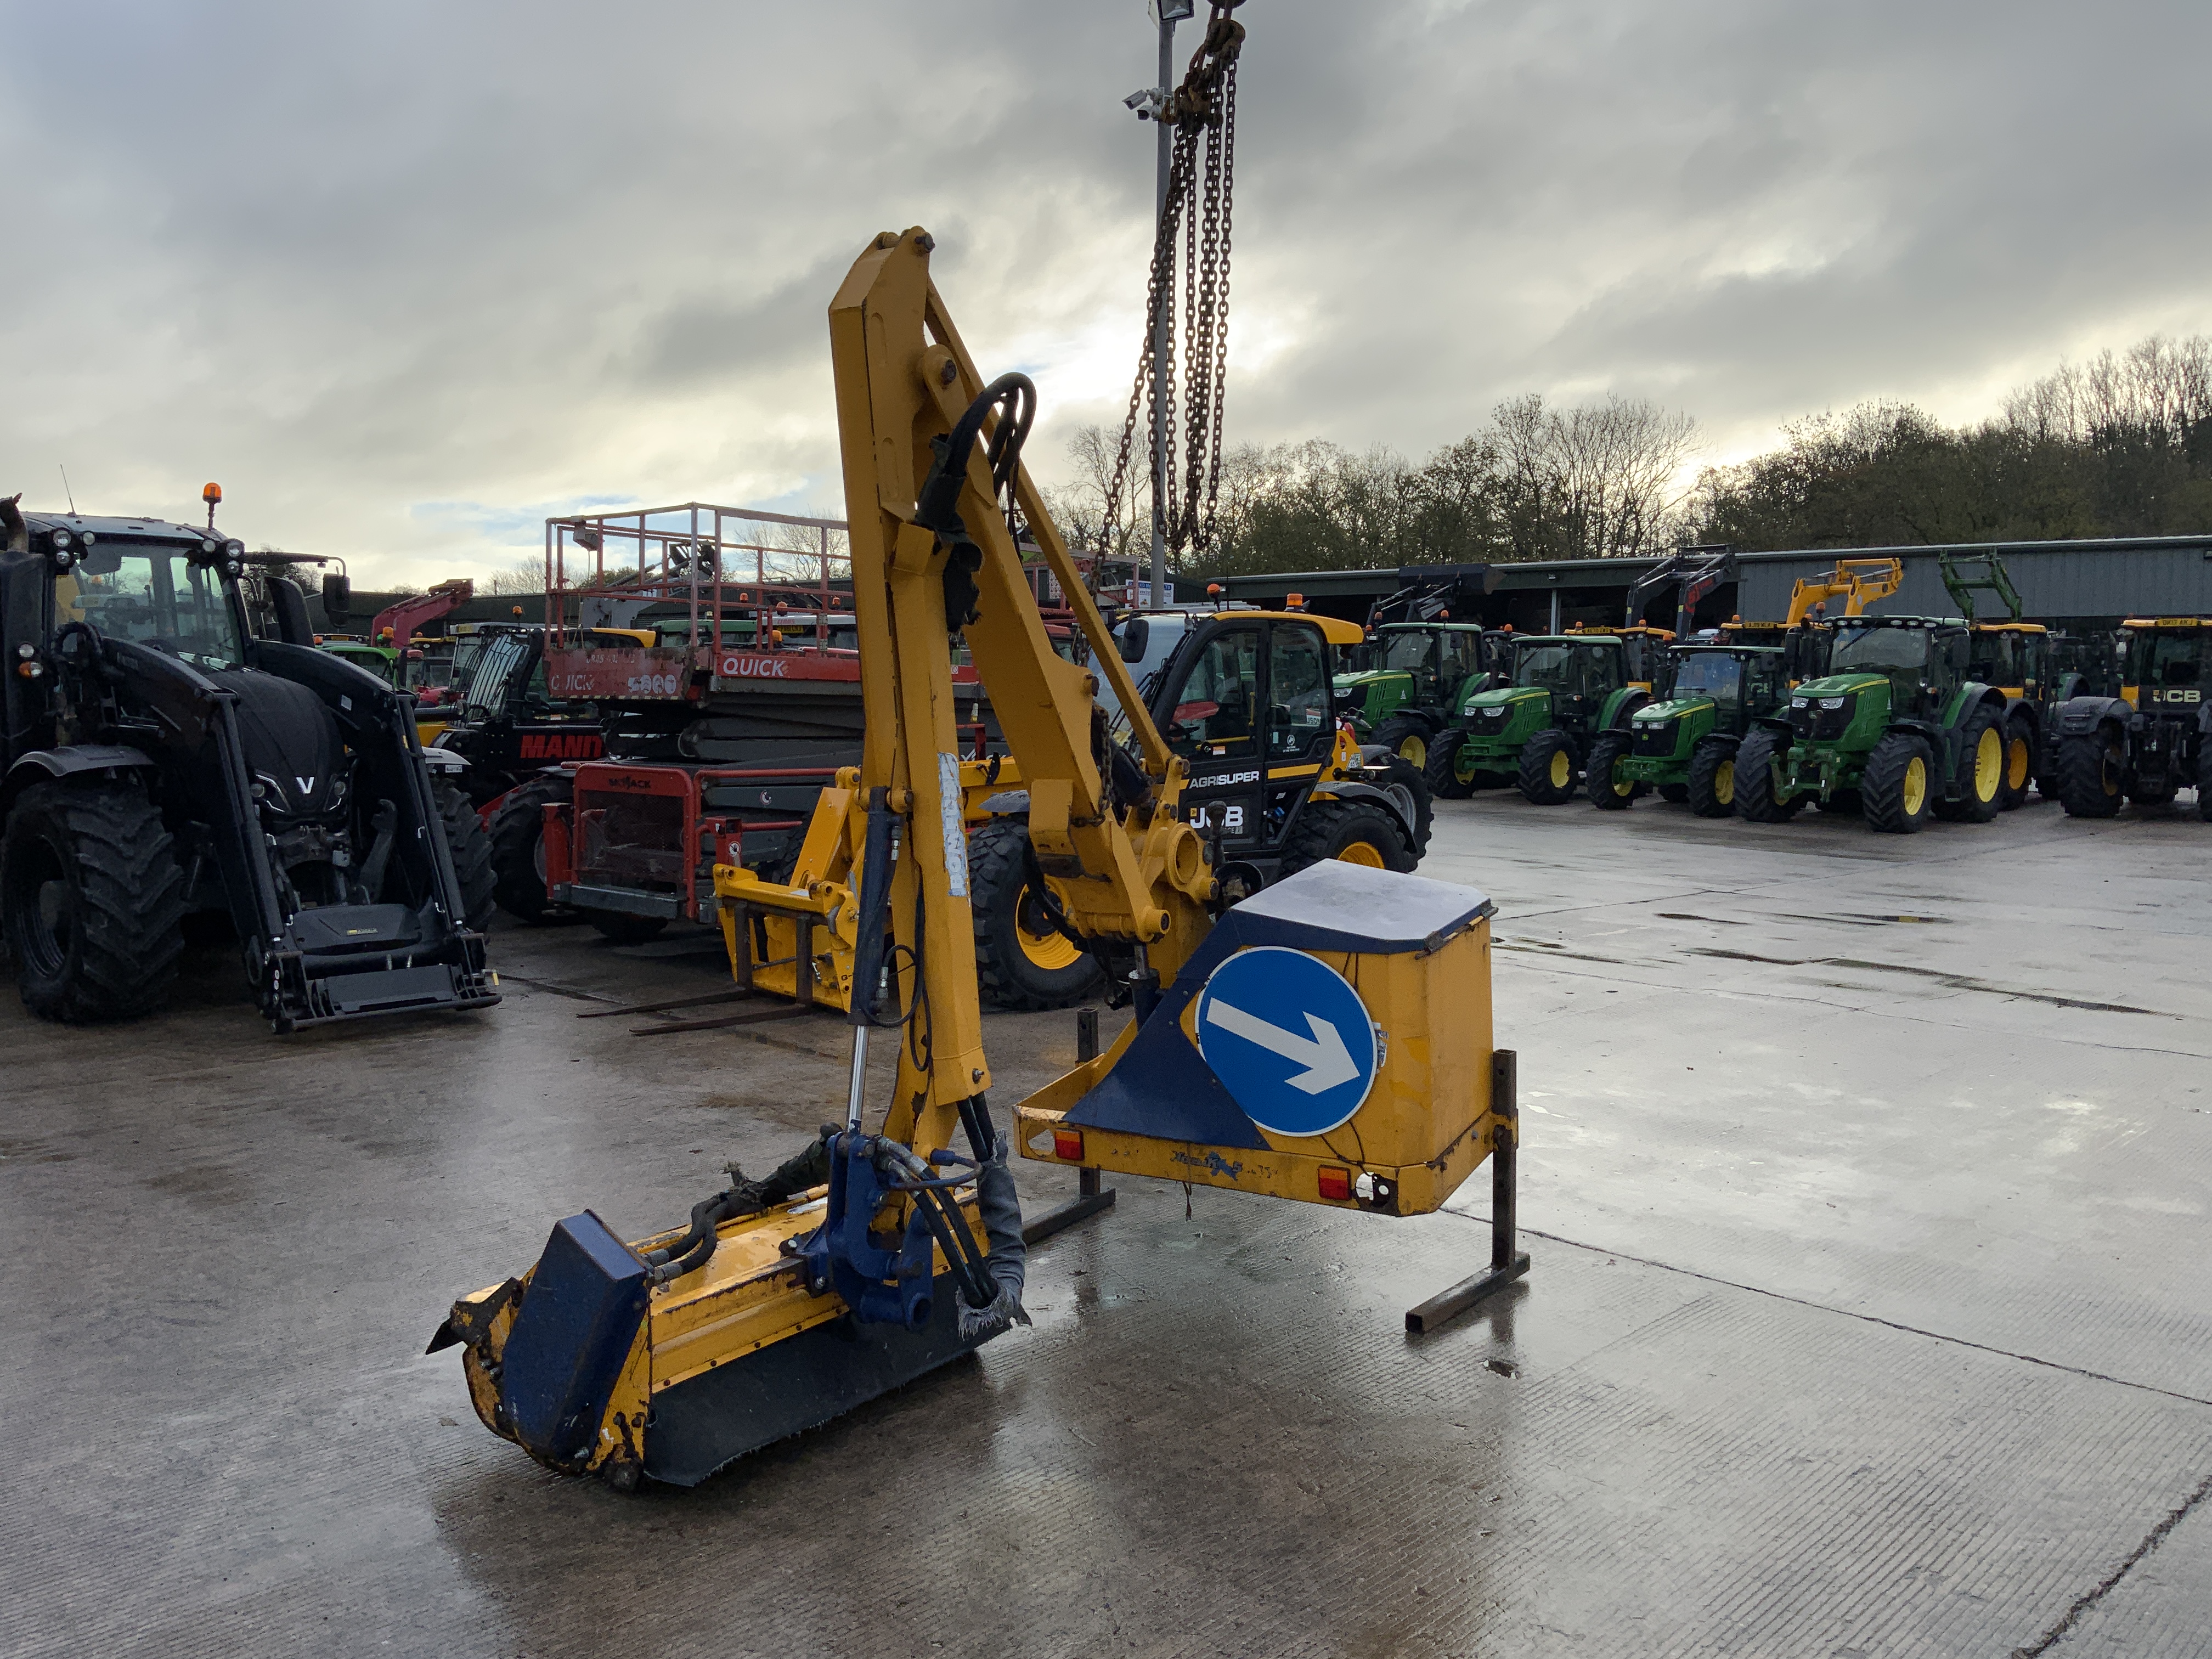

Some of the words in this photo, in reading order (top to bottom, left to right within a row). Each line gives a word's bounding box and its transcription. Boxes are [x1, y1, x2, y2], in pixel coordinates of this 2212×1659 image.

[723, 657, 787, 677] QUICK
[2153, 690, 2201, 702] JCB
[1189, 771, 1260, 789] AGRISUPER
[1190, 806, 1243, 829] JB
